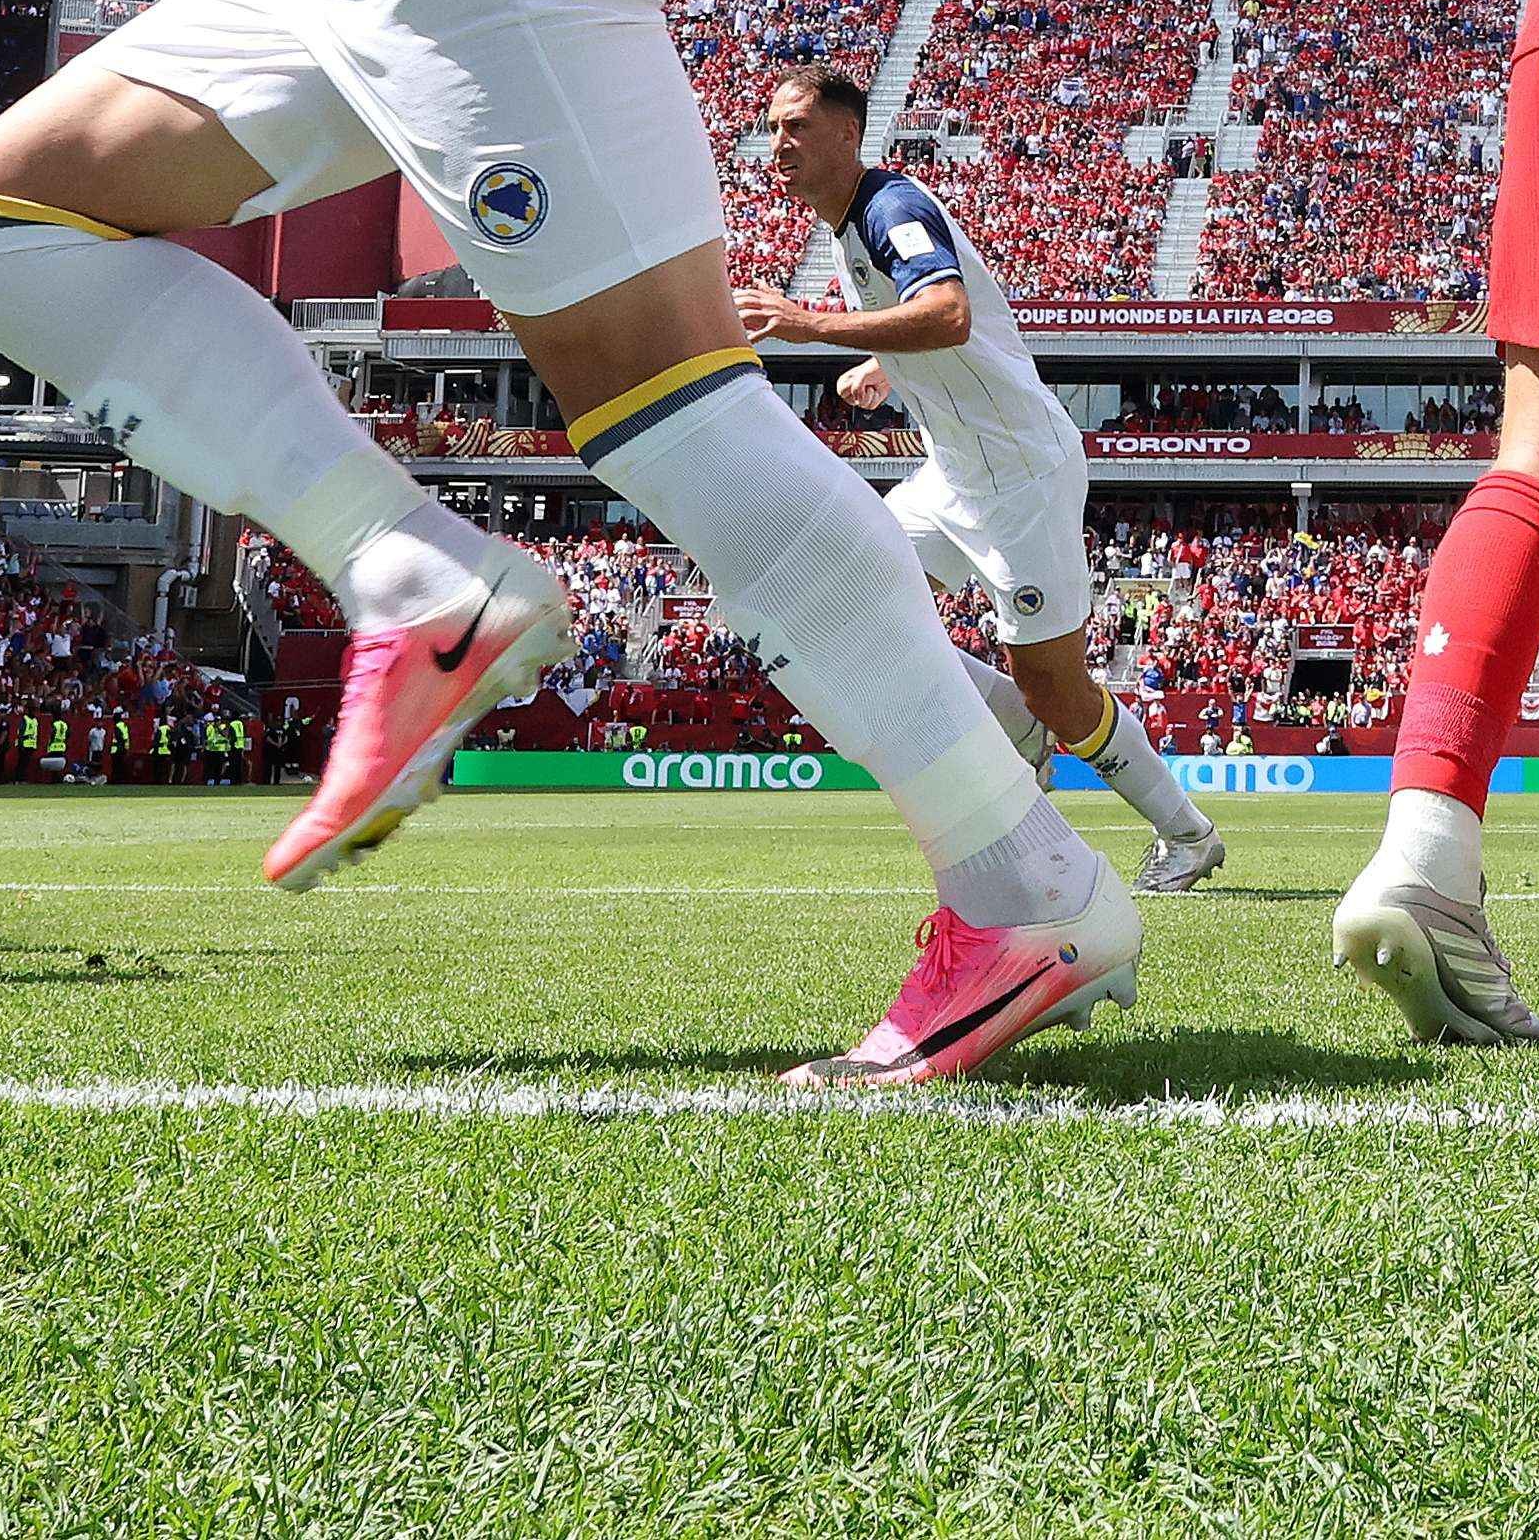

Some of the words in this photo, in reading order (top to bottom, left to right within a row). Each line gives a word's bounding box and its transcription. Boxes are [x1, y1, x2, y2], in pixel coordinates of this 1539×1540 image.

[1070, 309, 1097, 325] DU
[1099, 308, 1167, 325] MONDE
[1169, 309, 1194, 325] DE
[1196, 309, 1220, 325] LA
[1223, 309, 1264, 325] FIFA
[1267, 309, 1334, 325] 2026
[1096, 437, 1251, 453] TORONTO
[622, 753, 823, 789] aramco
